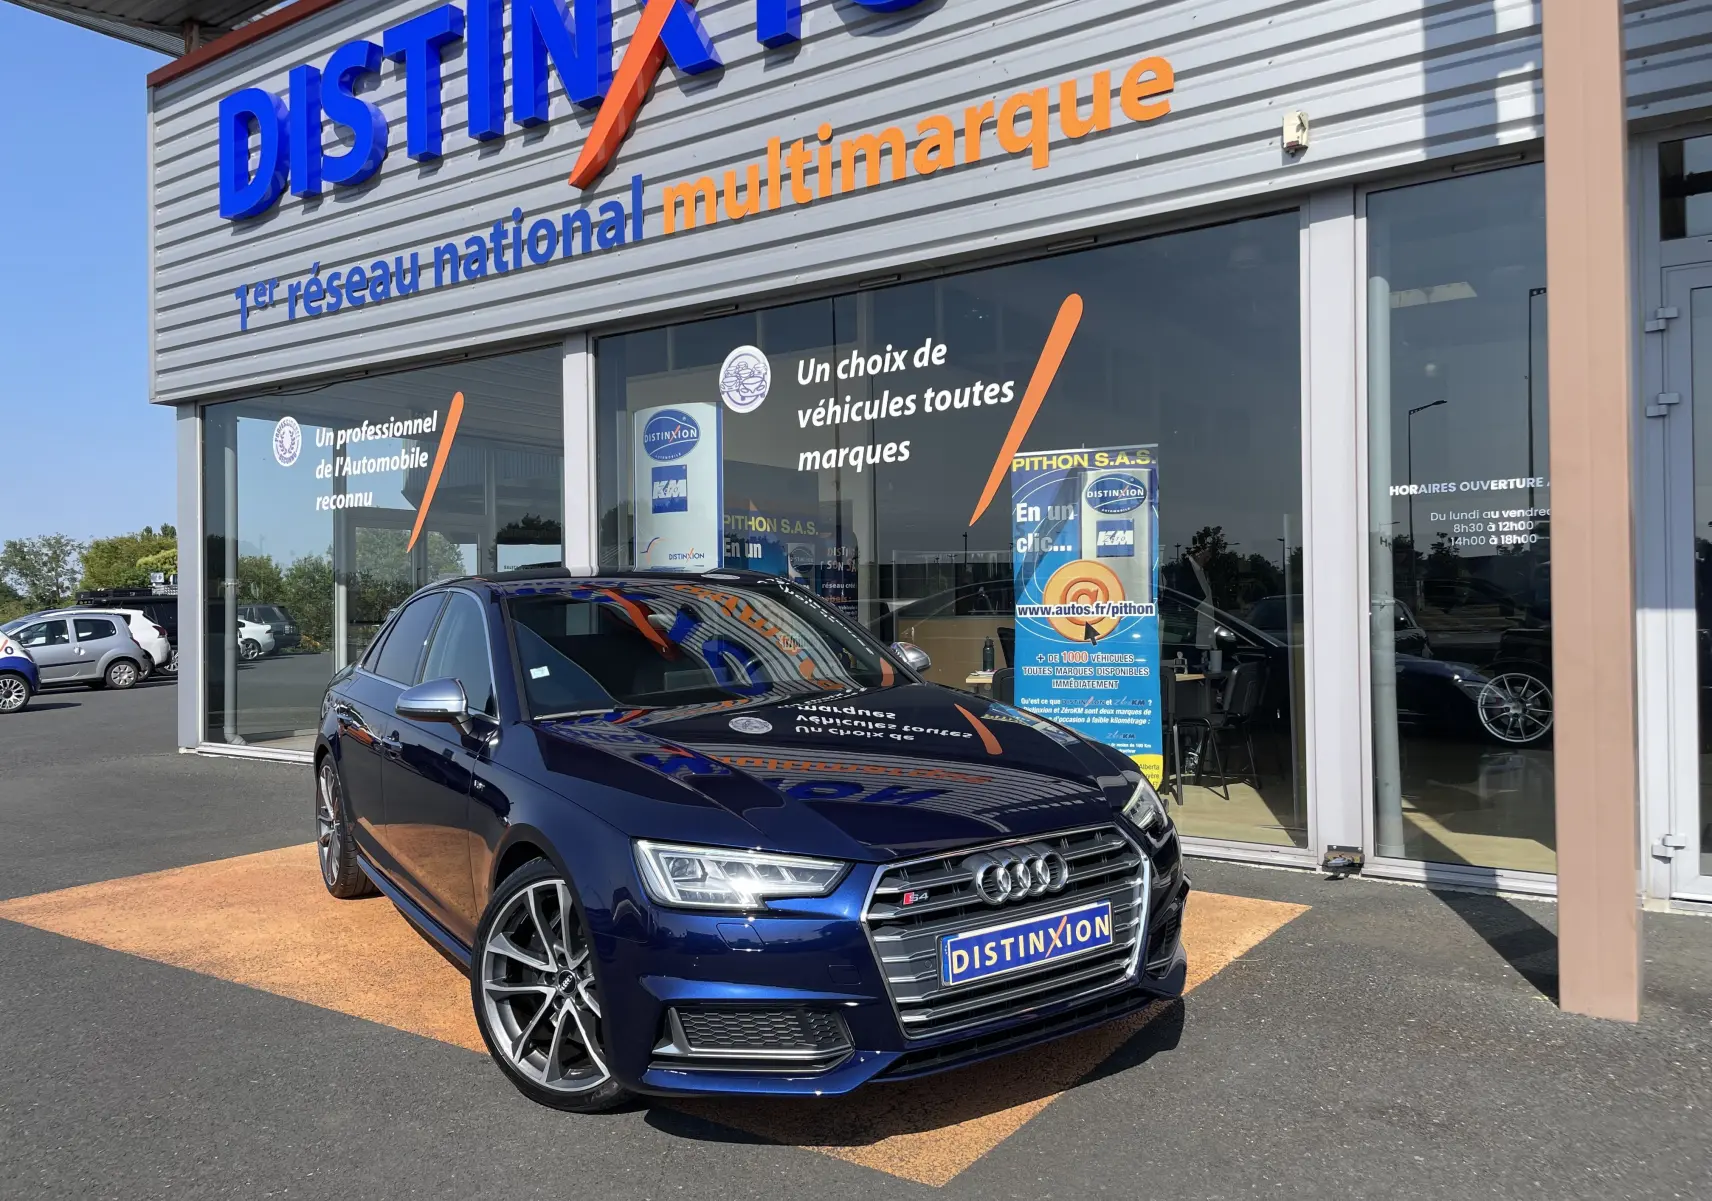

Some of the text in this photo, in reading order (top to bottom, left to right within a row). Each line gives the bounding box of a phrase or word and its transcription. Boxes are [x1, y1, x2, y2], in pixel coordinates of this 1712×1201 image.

[288, 253, 419, 321] réseau
[434, 174, 644, 288] national
[663, 56, 1175, 235] multimarque
[797, 337, 947, 386] Un choix de
[797, 380, 1015, 428] véhicules toutes
[315, 410, 438, 450] Un professionnel
[644, 424, 697, 443] DISTINXION
[315, 450, 429, 479] de l'Automobile
[797, 439, 911, 473] marques
[1012, 450, 1157, 472] PITHON S.A.S.
[1087, 485, 1145, 499] DISTINXION
[1389, 482, 1457, 496] HORAIRES
[1459, 477, 1544, 491] OUVERTURE
[315, 490, 373, 511] reconnu
[1016, 503, 1075, 522] En un
[1430, 512, 1446, 521] Du
[1450, 510, 1480, 521] lundi
[1482, 511, 1499, 520] au
[781, 518, 819, 536] S.A.S.
[1453, 520, 1534, 533] 8h30 à 12h00
[1016, 532, 1072, 553] clic...
[1097, 530, 1134, 546] KM
[1451, 533, 1538, 546] 14h00 à 18h00
[668, 547, 705, 563] DISTINXION
[745, 542, 762, 559] un
[1017, 602, 1154, 618] www.autos.fr/pithon
[1048, 654, 1059, 663] DE
[1061, 651, 1088, 663] 1000
[1090, 652, 1134, 663] VÉHICULES
[1022, 667, 1150, 676] TOUTES MARQUES DISPONIBLES
[1052, 678, 1119, 689] IMMÉDIATEMENT
[910, 892, 929, 902] S4
[952, 914, 1110, 974] DISTINXION
